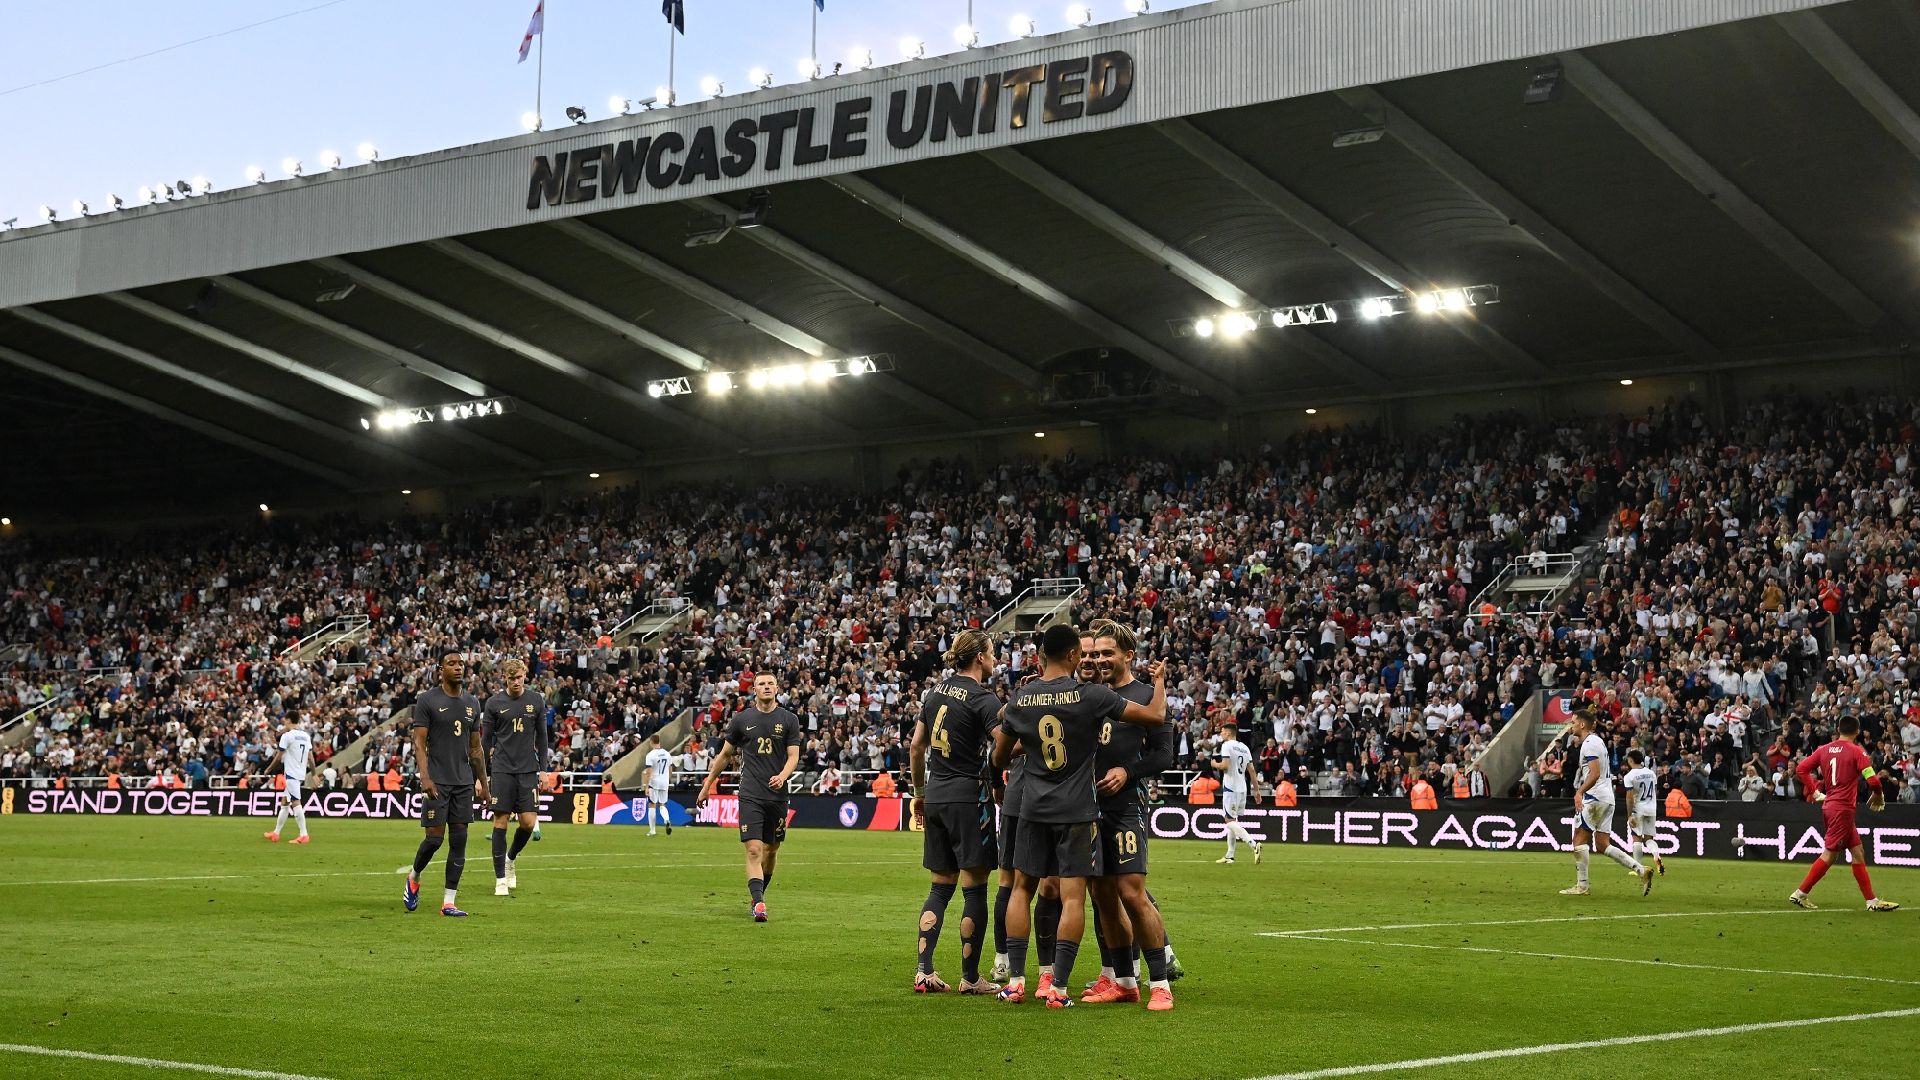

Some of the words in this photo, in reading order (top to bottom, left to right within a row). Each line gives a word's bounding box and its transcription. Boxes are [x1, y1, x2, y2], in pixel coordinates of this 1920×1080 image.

[526, 96, 872, 209] NEWCASTLE
[886, 50, 1134, 149] UNITED
[1017, 690, 1081, 707] ALEXANDER-ARNOLD
[454, 720, 462, 737] 3
[512, 717, 524, 733] 14
[931, 704, 951, 758] 4
[1101, 722, 1112, 745] 8
[300, 743, 305, 763] 7
[757, 736, 773, 754] 23
[1038, 714, 1067, 771] 8
[657, 758, 667, 775] 17
[1237, 755, 1244, 775] 3
[1830, 757, 1837, 786] 1
[1639, 780, 1654, 801] 24
[28, 790, 121, 814] STAND
[128, 790, 295, 816] TOGETHER
[303, 791, 422, 818] AGAINS
[720, 798, 739, 824] 202
[1149, 806, 1418, 845] OGETHER
[1116, 830, 1138, 855] 18
